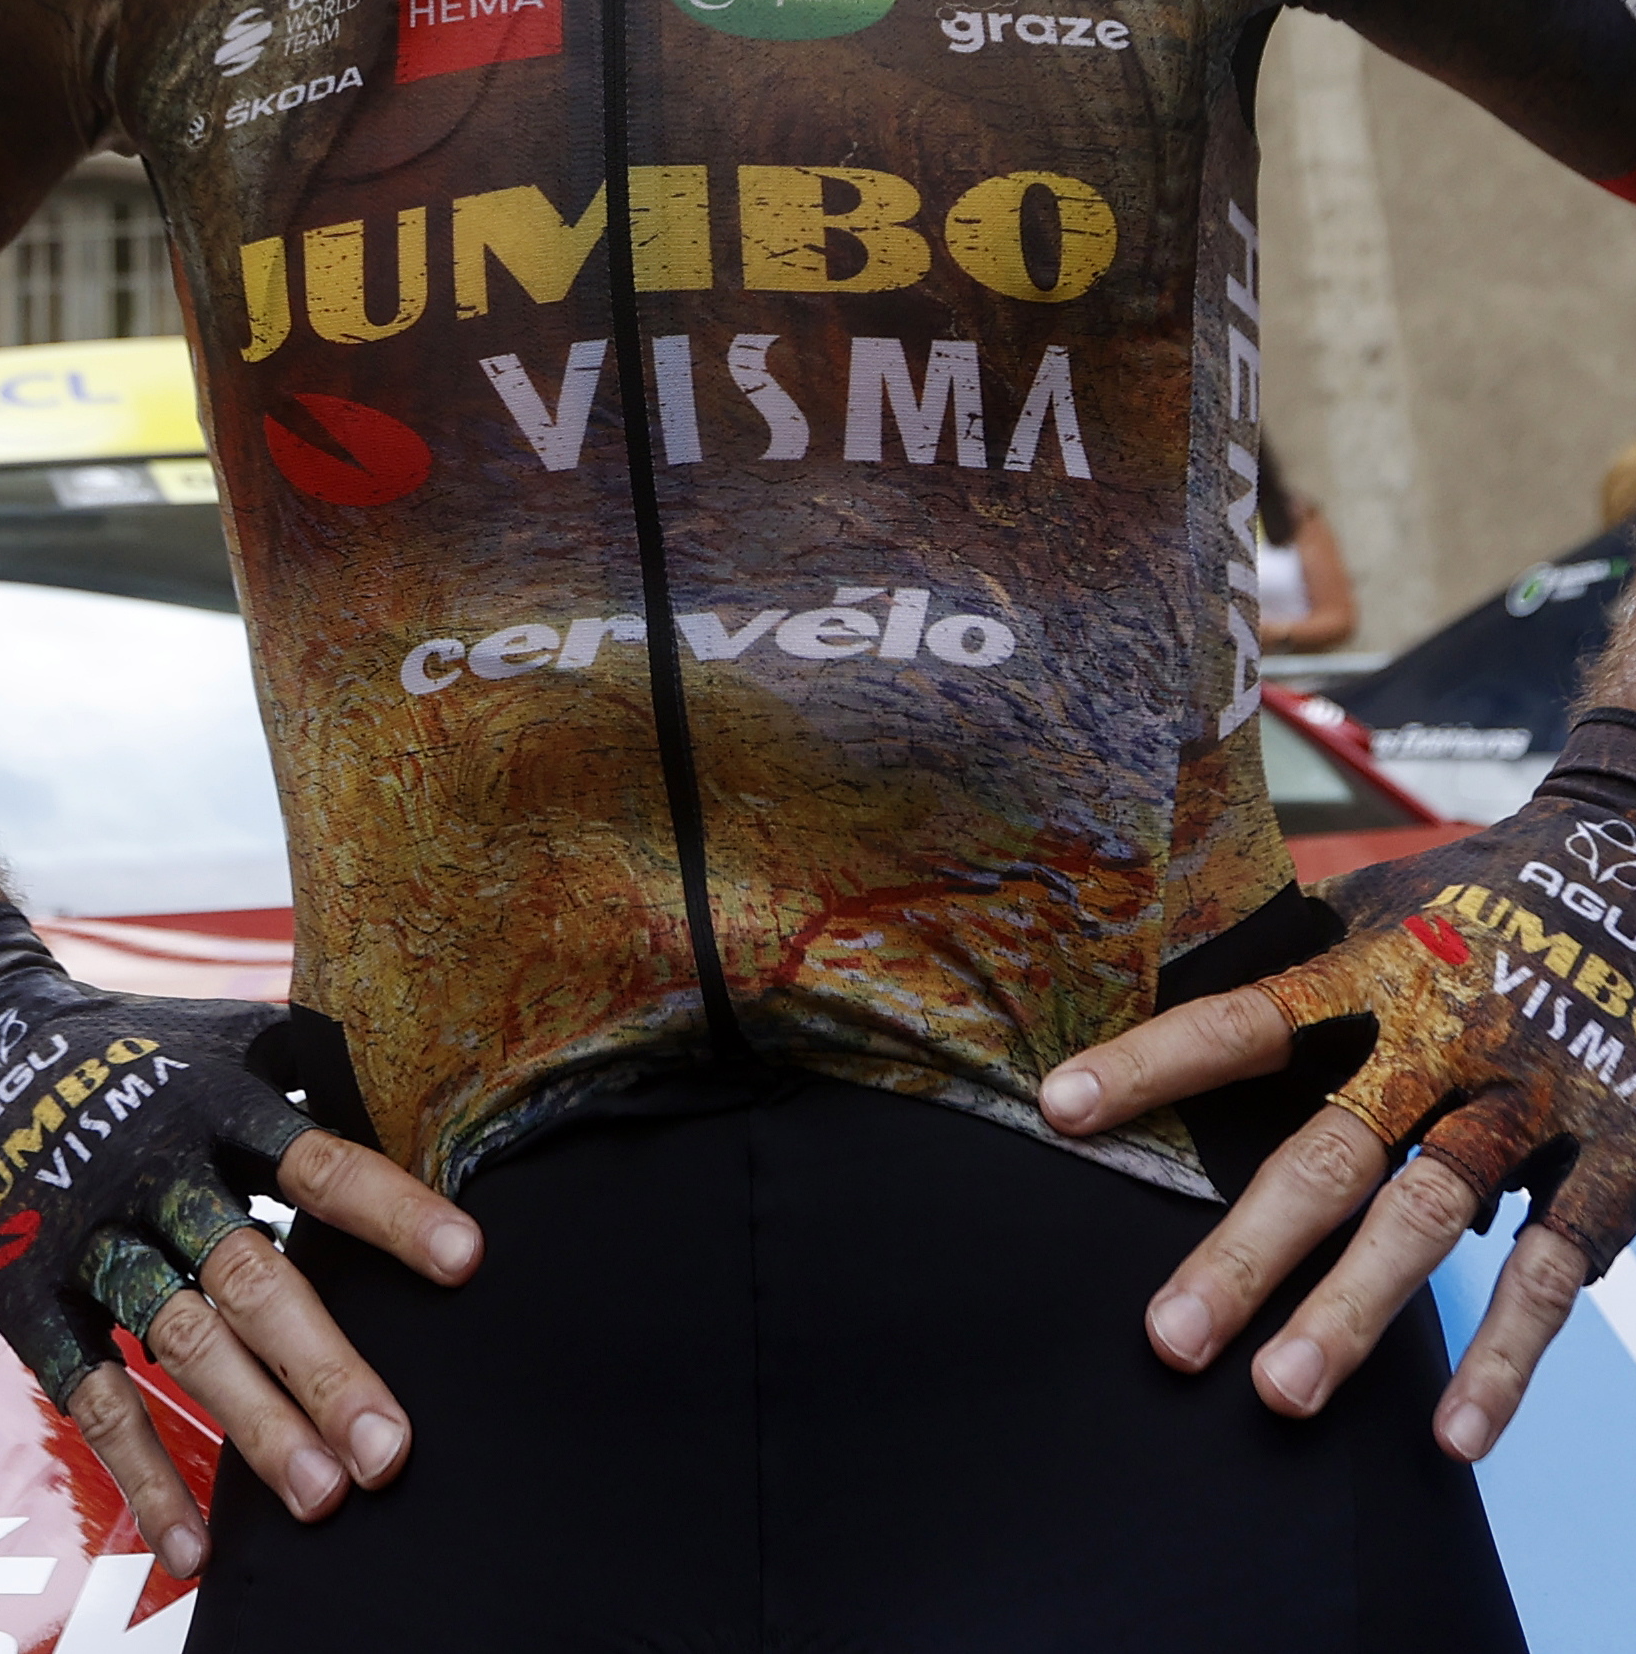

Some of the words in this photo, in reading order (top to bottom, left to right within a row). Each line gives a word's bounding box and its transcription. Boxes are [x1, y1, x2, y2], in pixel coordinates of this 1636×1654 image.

[282, 18, 342, 57] TEAM
[940, 10, 1131, 54] graze
[224, 65, 363, 129] ŠKODA
[239, 163, 1119, 364] JUMBO
[478, 332, 1093, 480] VISMA
[399, 585, 1017, 696] cervélo
[33, 1054, 190, 1191] VISMA
